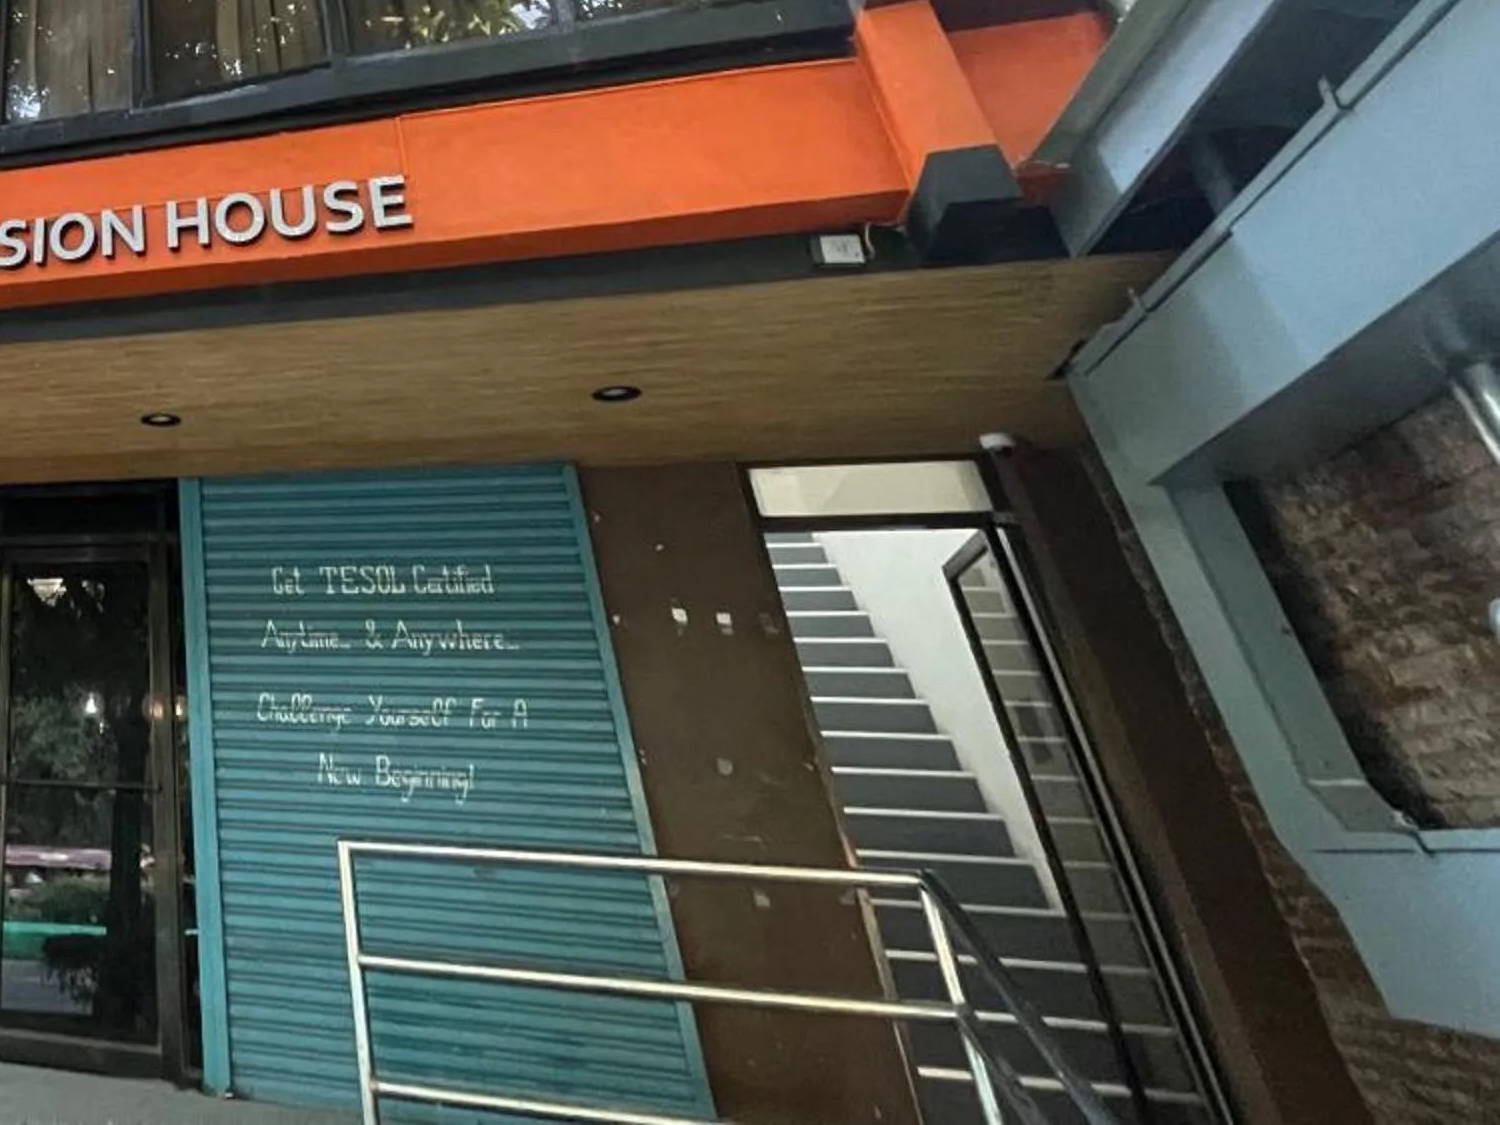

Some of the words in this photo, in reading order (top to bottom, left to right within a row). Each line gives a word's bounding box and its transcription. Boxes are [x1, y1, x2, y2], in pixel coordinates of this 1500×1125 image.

[164, 174, 414, 251] HOUSE
[271, 566, 305, 595] Get
[319, 565, 406, 595] TESOL
[364, 618, 384, 652] &
[364, 694, 457, 729] Yourself
[469, 697, 501, 730] For
[512, 697, 529, 730] A
[317, 751, 362, 788] New
